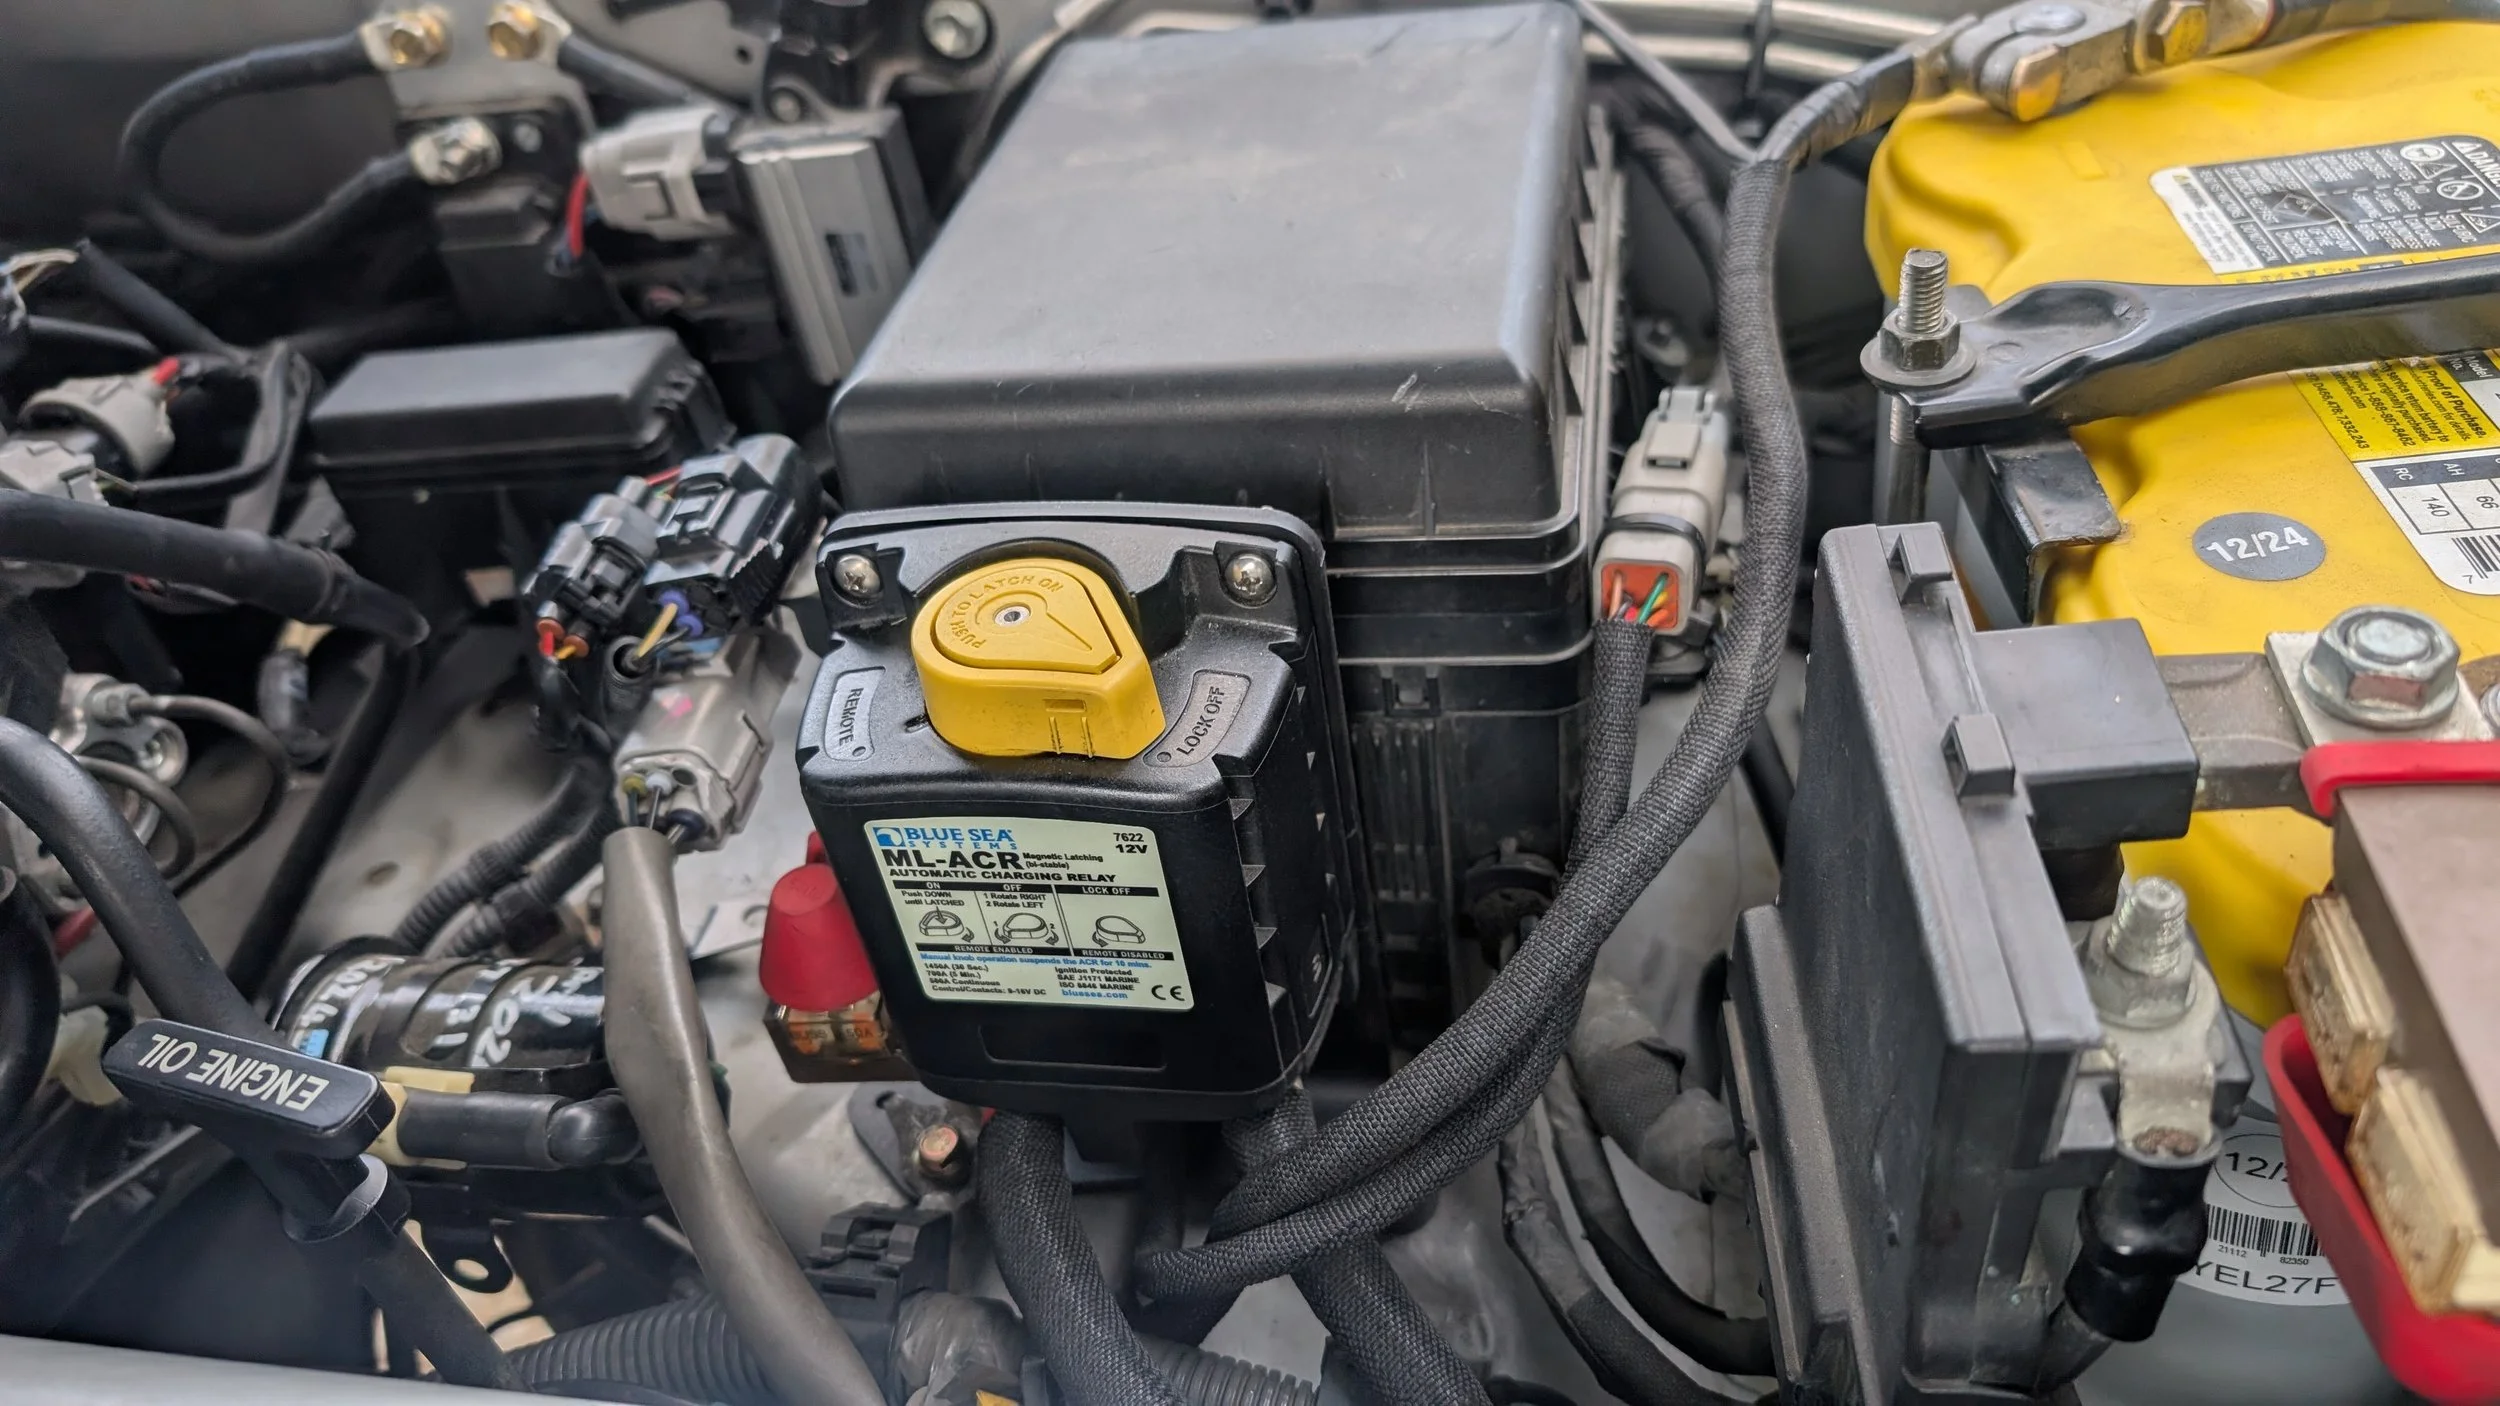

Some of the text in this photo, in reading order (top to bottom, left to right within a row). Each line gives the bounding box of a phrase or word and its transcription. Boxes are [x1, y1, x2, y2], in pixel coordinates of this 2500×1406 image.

[2465, 356, 2493, 378] Model
[2425, 370, 2486, 439] Proof of Purchase.
[2393, 467, 2413, 481] RC
[2443, 463, 2465, 476] AH
[2421, 496, 2450, 517] 140
[2476, 496, 2500, 509] 66
[2206, 526, 2309, 562] 12/24
[950, 575, 1064, 648] PUSH TO LATCH ON
[839, 687, 864, 746] REMOTE
[1176, 686, 1225, 755] LOCK OFF
[904, 827, 1015, 842] BLUE SEA
[1113, 832, 1144, 842] 7622
[910, 841, 1017, 850] SYSTEMS
[1115, 844, 1148, 854] 12V
[881, 849, 1025, 870] ML-ACR
[1022, 852, 1103, 862] Magnetic Latching
[889, 869, 1116, 882] AUTOMATIC CHARGING RELAY
[926, 881, 941, 889] ON
[1082, 886, 1131, 895] LOCK OFF
[925, 899, 965, 907] LATCHED
[954, 945, 1033, 954] REMOTE ENABLED
[1121, 951, 1165, 959] DISABLED
[1055, 967, 1132, 976] Ignition Protected
[1105, 976, 1140, 984] MARINE
[1062, 989, 1128, 999] bluesea.com
[138, 1033, 329, 1112] ENGINE OIL
[2218, 1244, 2248, 1258] 21112
[2279, 1256, 2309, 1266] 82350
[2194, 1261, 2339, 1294] YEL27F
